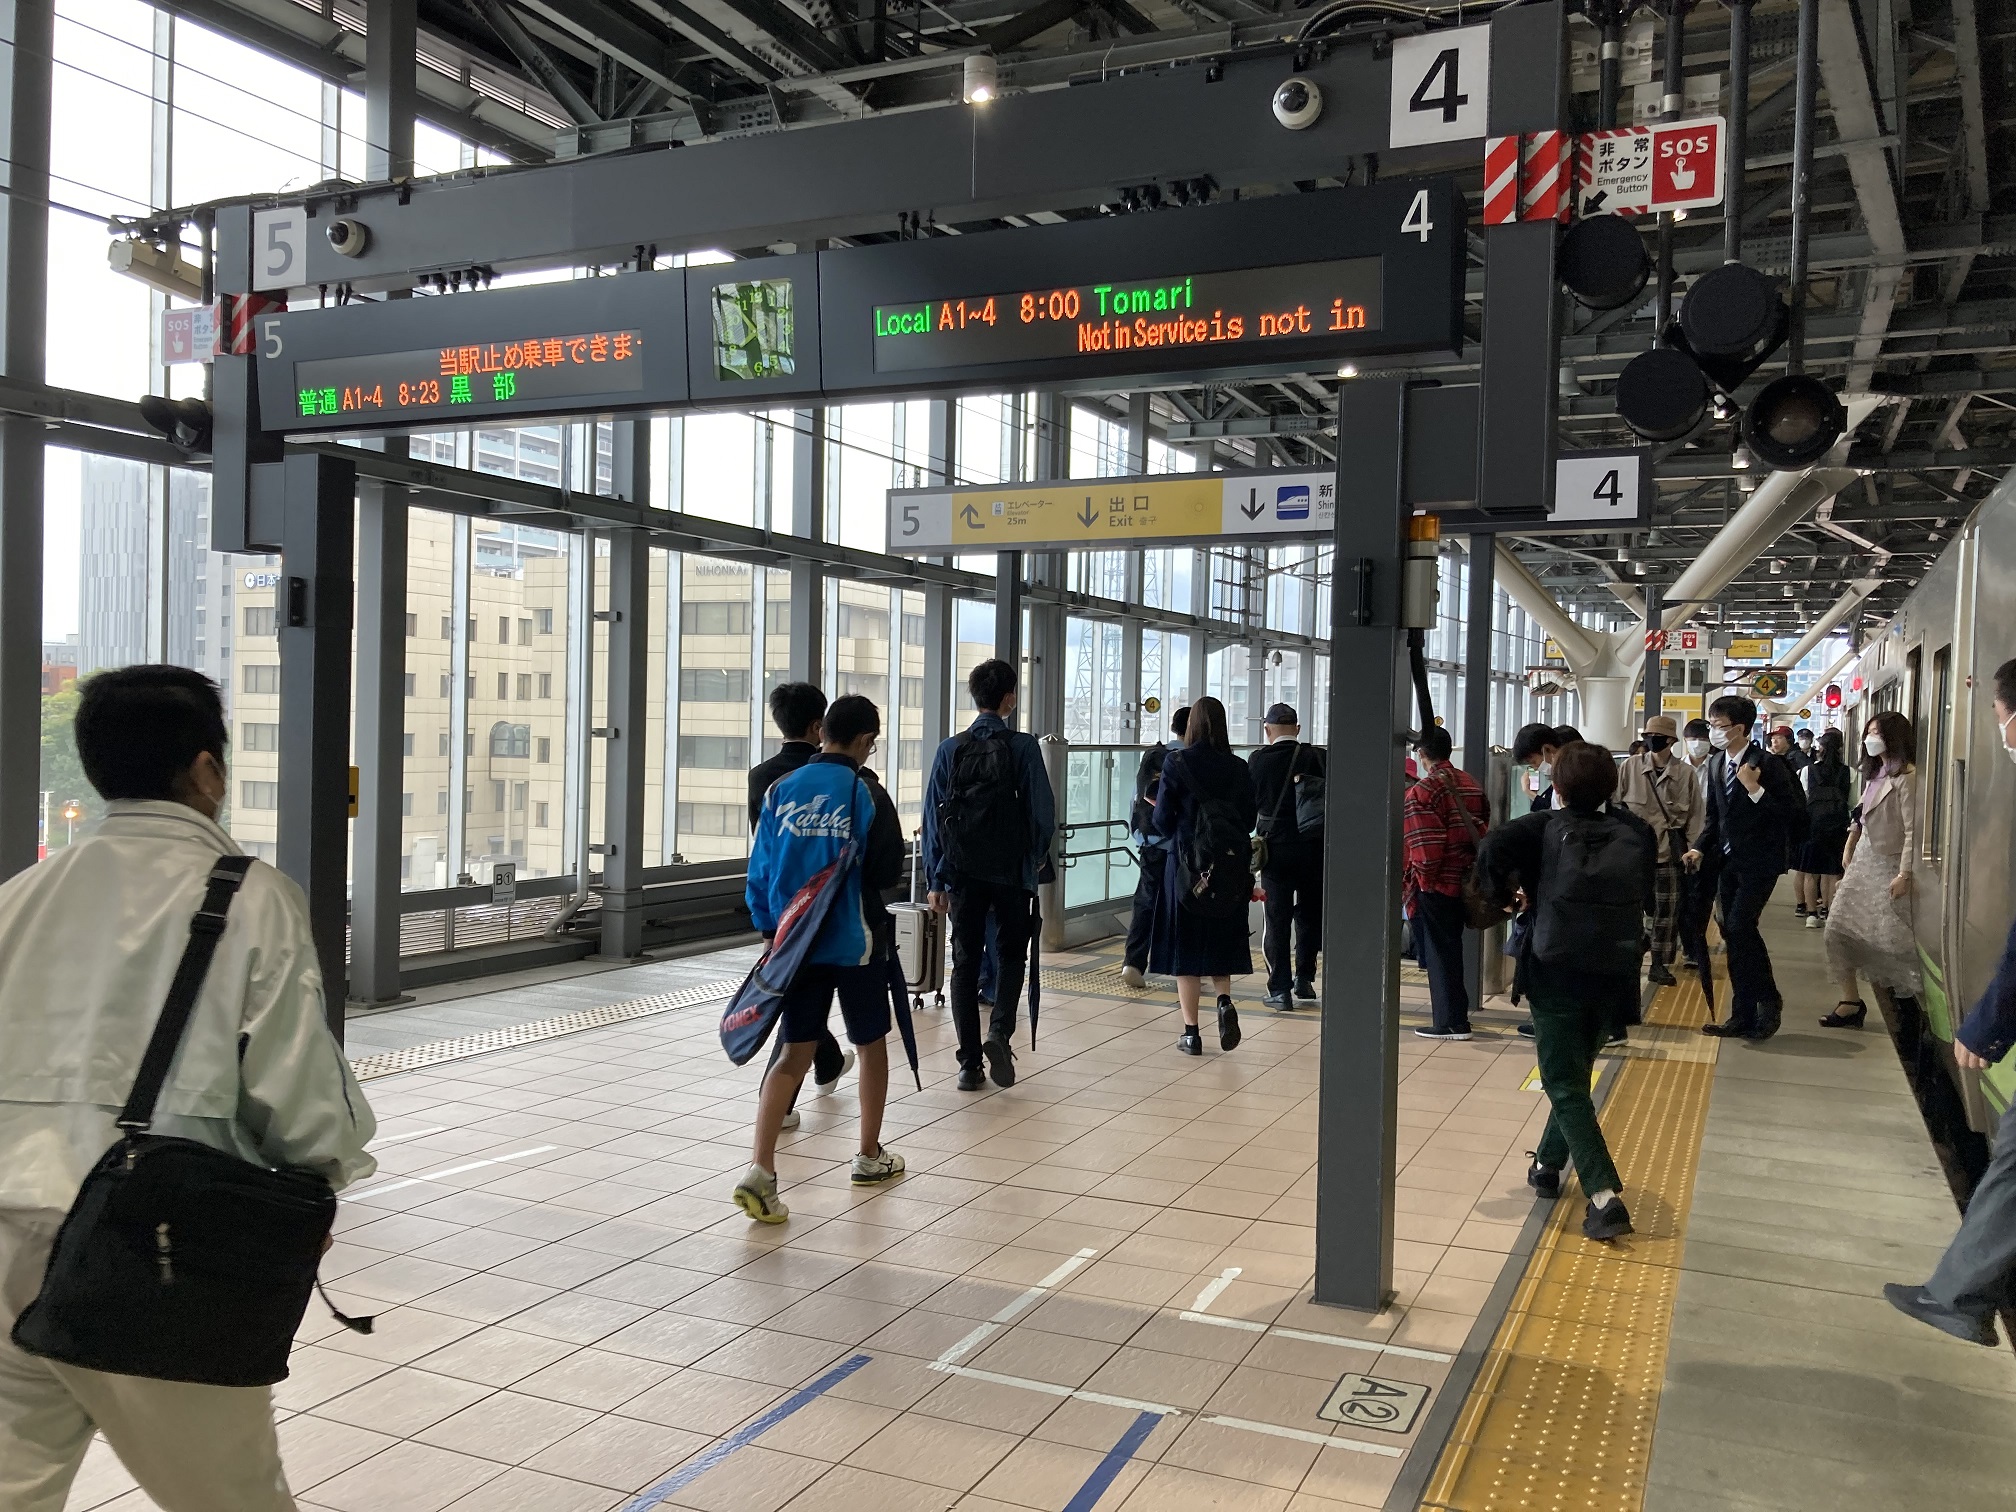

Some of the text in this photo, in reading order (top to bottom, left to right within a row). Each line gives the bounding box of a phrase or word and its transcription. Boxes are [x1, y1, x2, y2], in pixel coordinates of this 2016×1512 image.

[1409, 47, 1469, 124] 4
[1599, 137, 1650, 157] 非常
[1660, 136, 1710, 158] SOS
[1598, 156, 1649, 174] ボタン
[1597, 173, 1649, 187] Emergency
[1616, 183, 1648, 195] Button
[1401, 189, 1434, 243] 4
[267, 221, 293, 276] 5
[875, 277, 1193, 337] Local A1~4 8:00 Tomari
[168, 319, 190, 332] SOS
[1078, 298, 1367, 353] Not in Service is not in
[264, 320, 283, 359] 5
[439, 333, 643, 376] 当駅止め乗車できま
[298, 371, 516, 417] 普通 A1~4 8:23 黒部
[1593, 469, 1624, 507] 4
[1007, 500, 1053, 510] エレベーター
[1109, 495, 1149, 513] 出口
[902, 505, 920, 537] 5
[1007, 517, 1027, 526] 25m
[1109, 514, 1133, 528] Exit
[257, 573, 281, 587] 日本
[1761, 679, 1770, 691] 4
[1149, 700, 1156, 711] 4
[775, 800, 852, 838] Kureha
